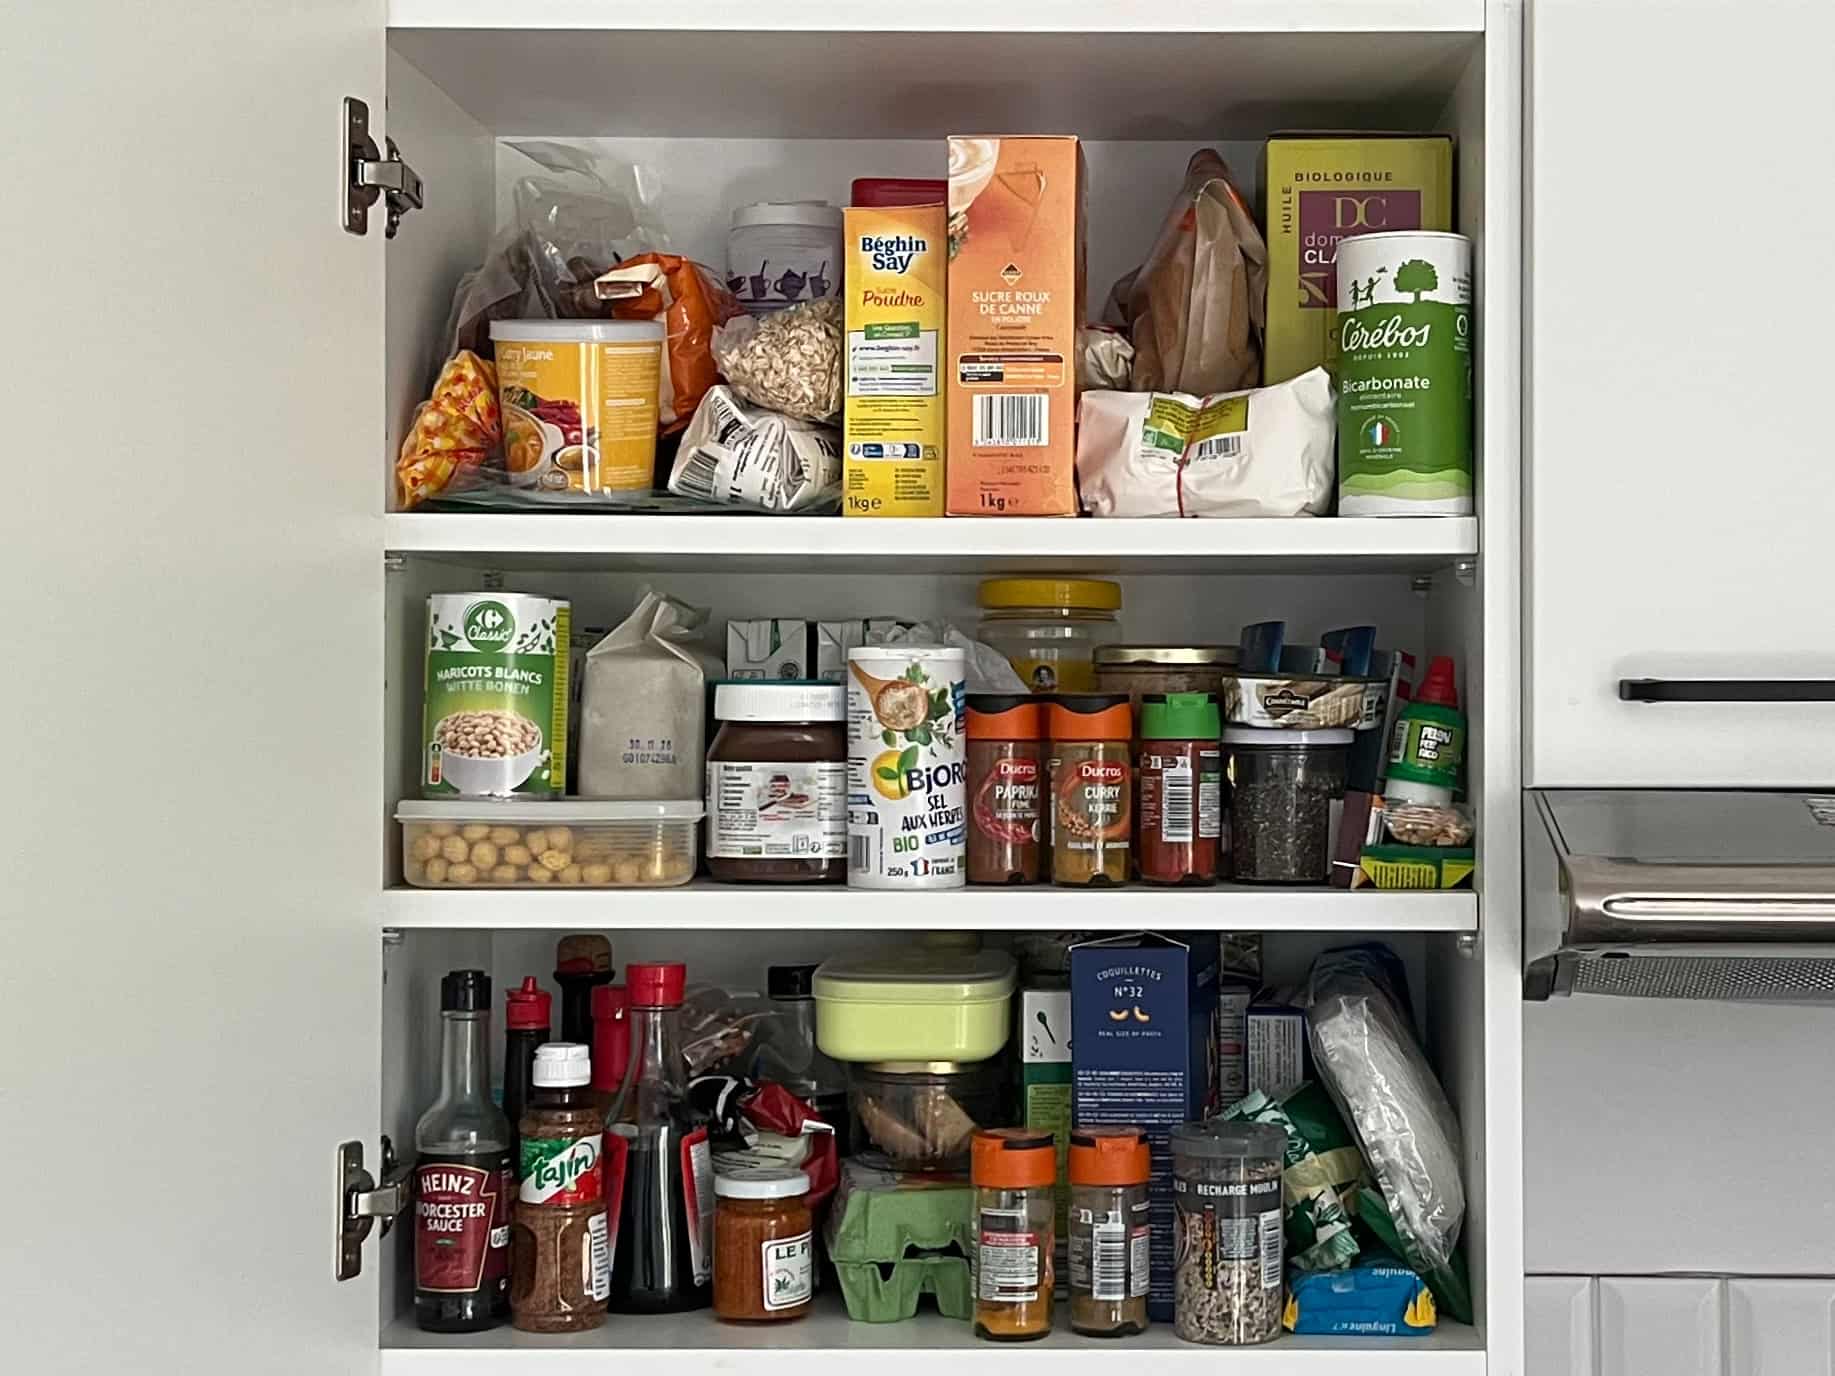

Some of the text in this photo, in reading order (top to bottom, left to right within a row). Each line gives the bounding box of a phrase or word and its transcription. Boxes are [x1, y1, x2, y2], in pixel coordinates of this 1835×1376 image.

[1295, 172, 1393, 182] BIOLOGIQUE
[1282, 187, 1292, 234] HUILE
[1335, 196, 1387, 228] DC
[862, 236, 926, 256] Béghin
[872, 252, 914, 274] Say
[863, 290, 925, 307] Poudre
[972, 291, 1050, 303] SUCRE ROUX
[979, 304, 1044, 315] DE CANNE
[1342, 314, 1431, 351] Cérébos
[1343, 376, 1430, 394] Bicarbonate
[848, 496, 869, 511] 1kg
[495, 667, 543, 685] BLANCS
[1082, 765, 1122, 777] Ducros
[1084, 786, 1120, 799] CURRY
[927, 794, 948, 812] SEL
[902, 814, 928, 832] AUX
[893, 834, 919, 853] BIO
[1097, 966, 1161, 981] COQUILLETTES
[421, 1173, 475, 1195] HEINZ
[1197, 1184, 1248, 1196] RECHARGE
[427, 1218, 463, 1232] SAUCE
[776, 1245, 797, 1260] LE
[1349, 1322, 1396, 1334] Linguine
